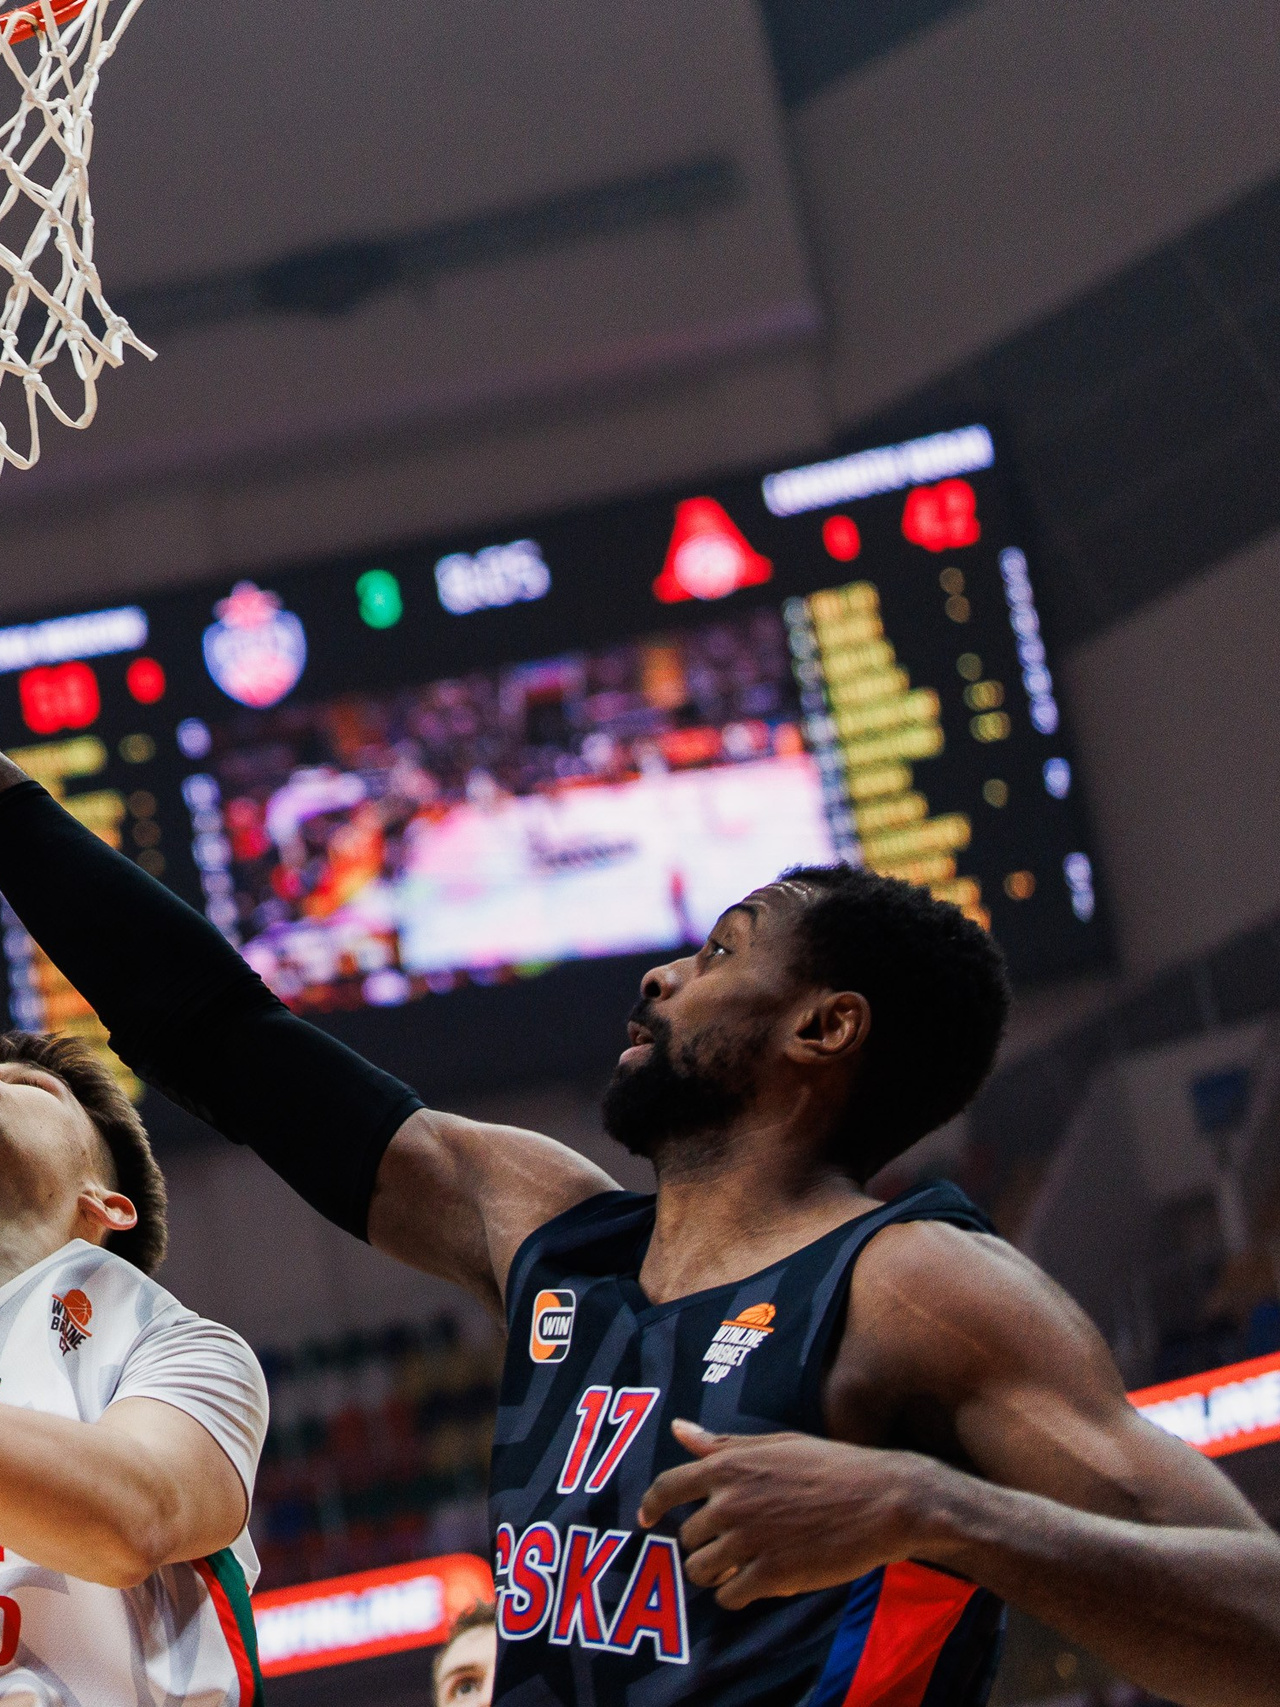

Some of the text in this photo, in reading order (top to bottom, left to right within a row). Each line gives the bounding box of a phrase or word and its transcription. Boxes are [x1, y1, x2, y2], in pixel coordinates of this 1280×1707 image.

[542, 1315, 571, 1336] WIN
[702, 1342, 752, 1367] BASKET
[701, 1362, 732, 1384] CUP
[556, 1384, 661, 1494] 17
